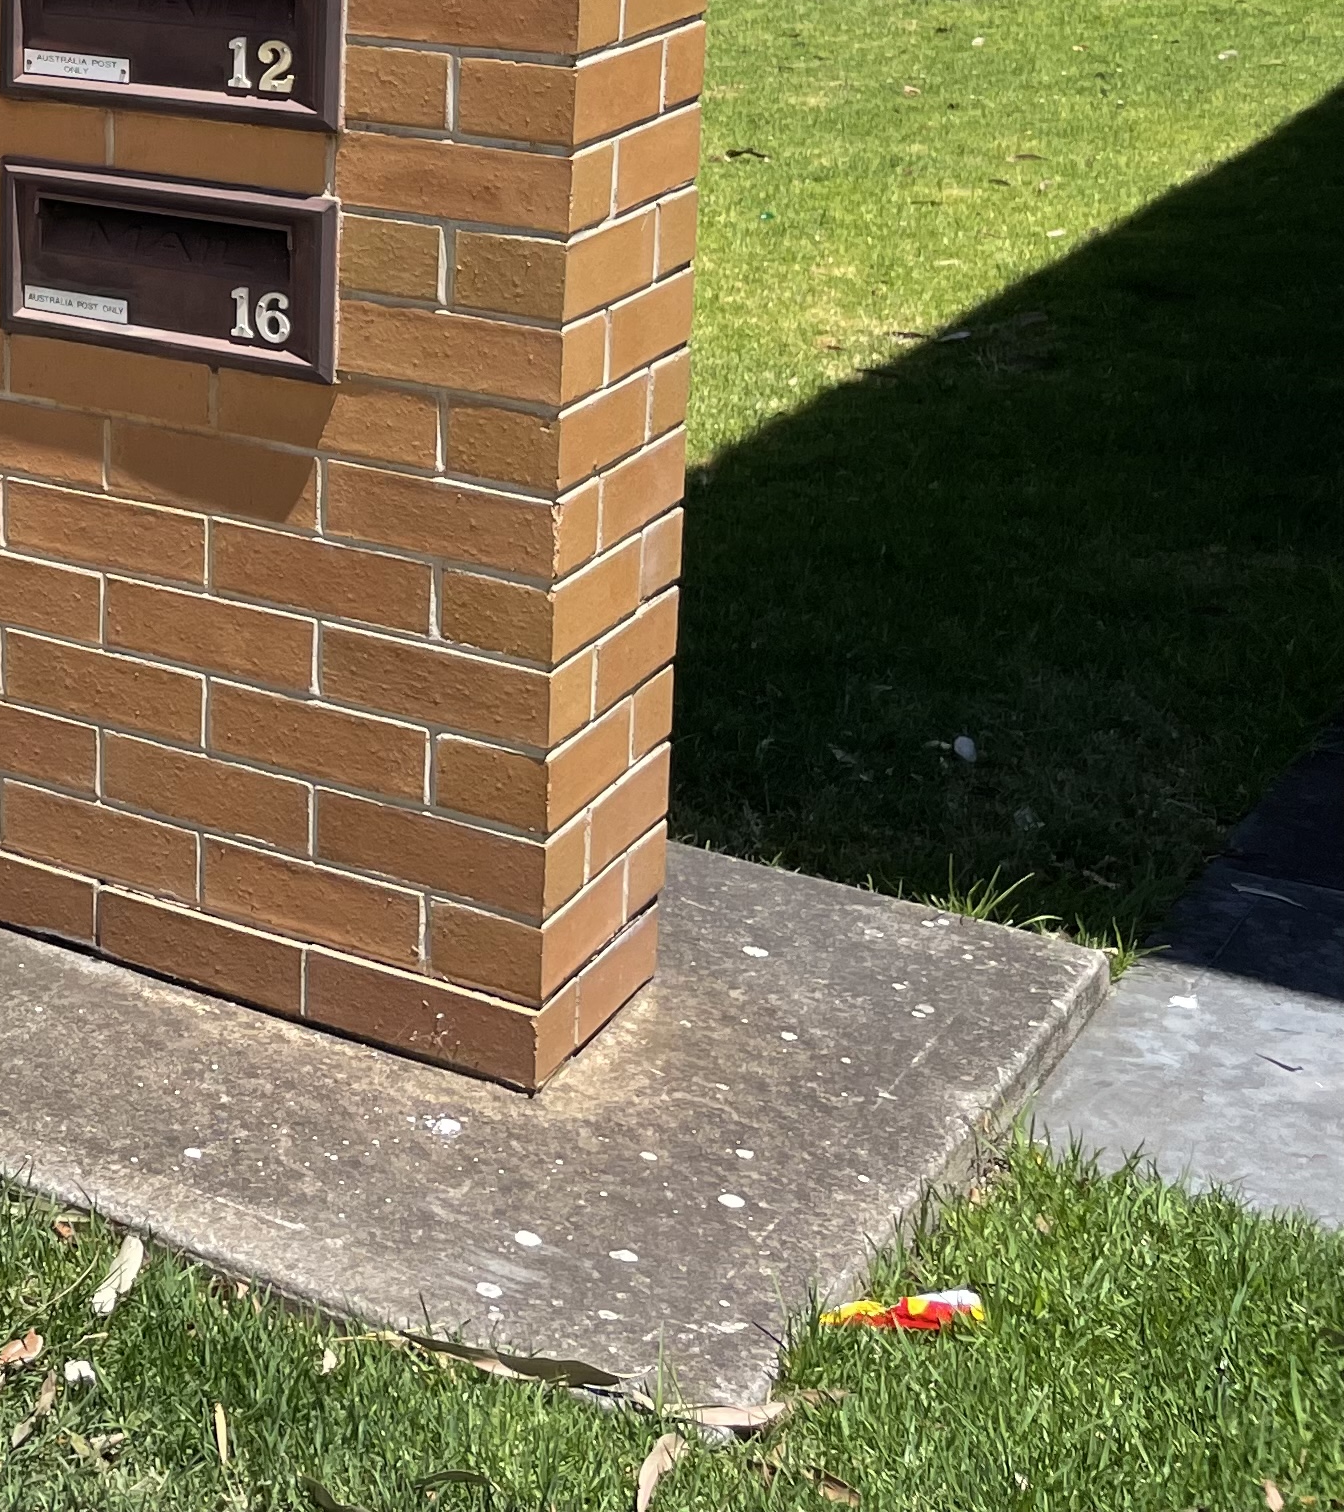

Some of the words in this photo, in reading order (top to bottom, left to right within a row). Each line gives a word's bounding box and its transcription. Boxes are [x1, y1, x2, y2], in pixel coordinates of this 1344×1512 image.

[36, 54, 87, 65] AUSTRALIA
[91, 59, 117, 68] POST
[63, 65, 89, 74] ONLY
[226, 36, 295, 94] 12
[28, 293, 73, 307] AUSTRALIA
[76, 300, 98, 311] POST
[102, 304, 124, 315] ONLY
[229, 286, 292, 344] 16
